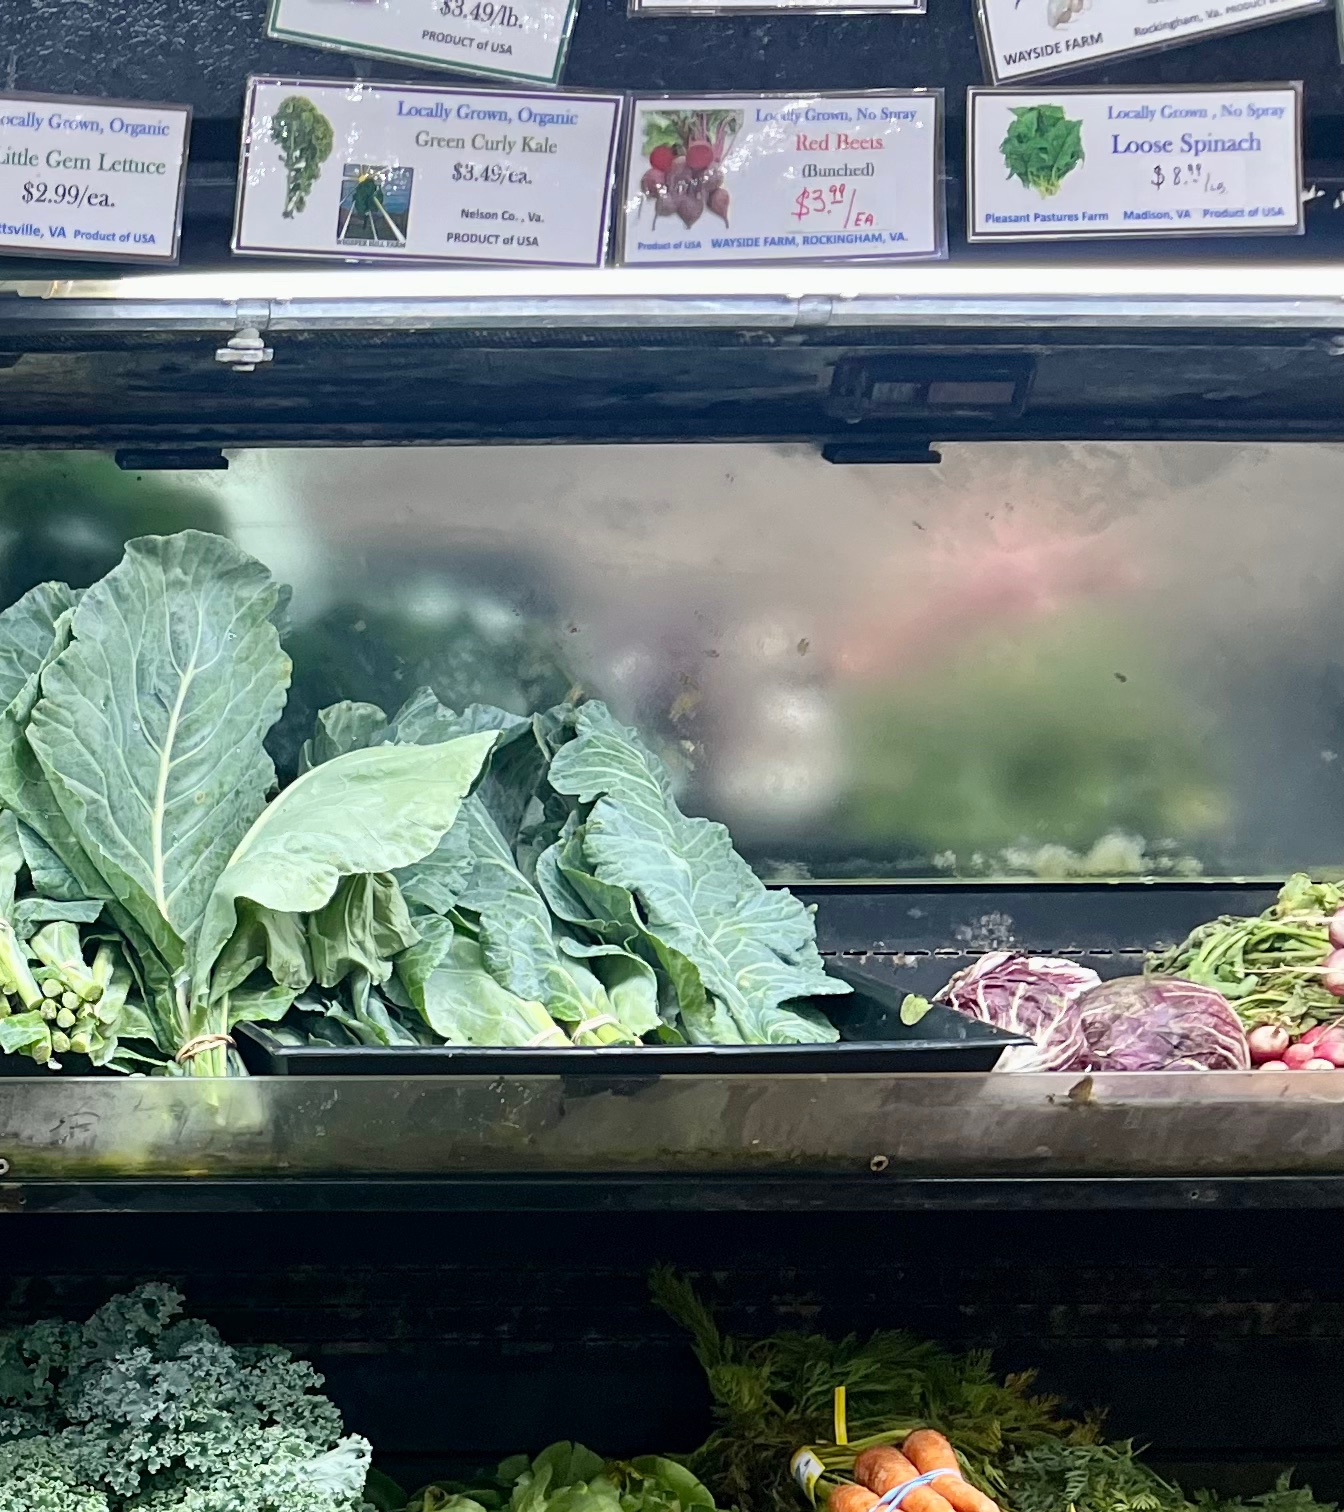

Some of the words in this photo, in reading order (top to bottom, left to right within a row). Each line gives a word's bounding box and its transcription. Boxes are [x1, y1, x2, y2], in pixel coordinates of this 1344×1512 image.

[439, 0, 523, 29] $3.49/lb.
[421, 29, 475, 49] PRODUCT
[476, 39, 489, 51] of
[491, 42, 513, 56] USA
[1003, 41, 1062, 66] WAYSIDE
[1065, 32, 1104, 52] FARM
[397, 100, 453, 122] Locally
[456, 103, 513, 124] Grown,
[518, 106, 579, 127] Organic
[805, 108, 852, 122] Grown,
[856, 108, 877, 120] No
[880, 107, 917, 122] Spray
[1108, 105, 1157, 122] Locally
[1220, 104, 1243, 118] No
[1247, 104, 1286, 120] Spray
[48, 113, 104, 134] Grown,
[109, 117, 170, 138] Organic
[415, 130, 466, 150] Green
[471, 131, 517, 153] Curly
[521, 134, 558, 154] Kale
[796, 134, 830, 151] Red
[1112, 134, 1174, 154] Loose
[1180, 131, 1262, 157] Spinach
[45, 150, 92, 171] Gem
[97, 153, 166, 175] Lettuce
[802, 163, 875, 179] (Bunched)
[452, 162, 533, 186] $3.49/ea.
[22, 181, 116, 208] $2.99/ea.
[461, 209, 498, 221] Nelson
[985, 212, 1031, 224] Pleasant
[1033, 212, 1079, 223] Pastures
[1082, 211, 1109, 221] Farm
[1123, 210, 1173, 222] Madison,
[1176, 210, 1191, 219] VA
[1202, 208, 1245, 219] Product
[1248, 207, 1259, 218] of
[1261, 206, 1285, 217] USA
[48, 227, 67, 239] VA
[74, 229, 117, 242] Product
[119, 231, 130, 243] of
[133, 232, 156, 244] USA
[447, 232, 500, 245] PRODUCT
[502, 234, 513, 245] of
[517, 235, 539, 246] USA
[638, 241, 671, 250] Product
[673, 241, 683, 250] of
[685, 241, 702, 249] USA
[711, 237, 761, 249] WAYSIDE
[764, 236, 800, 248] FARM,
[803, 233, 886, 246] ROCKINGHAM,
[889, 232, 908, 242] VA.
